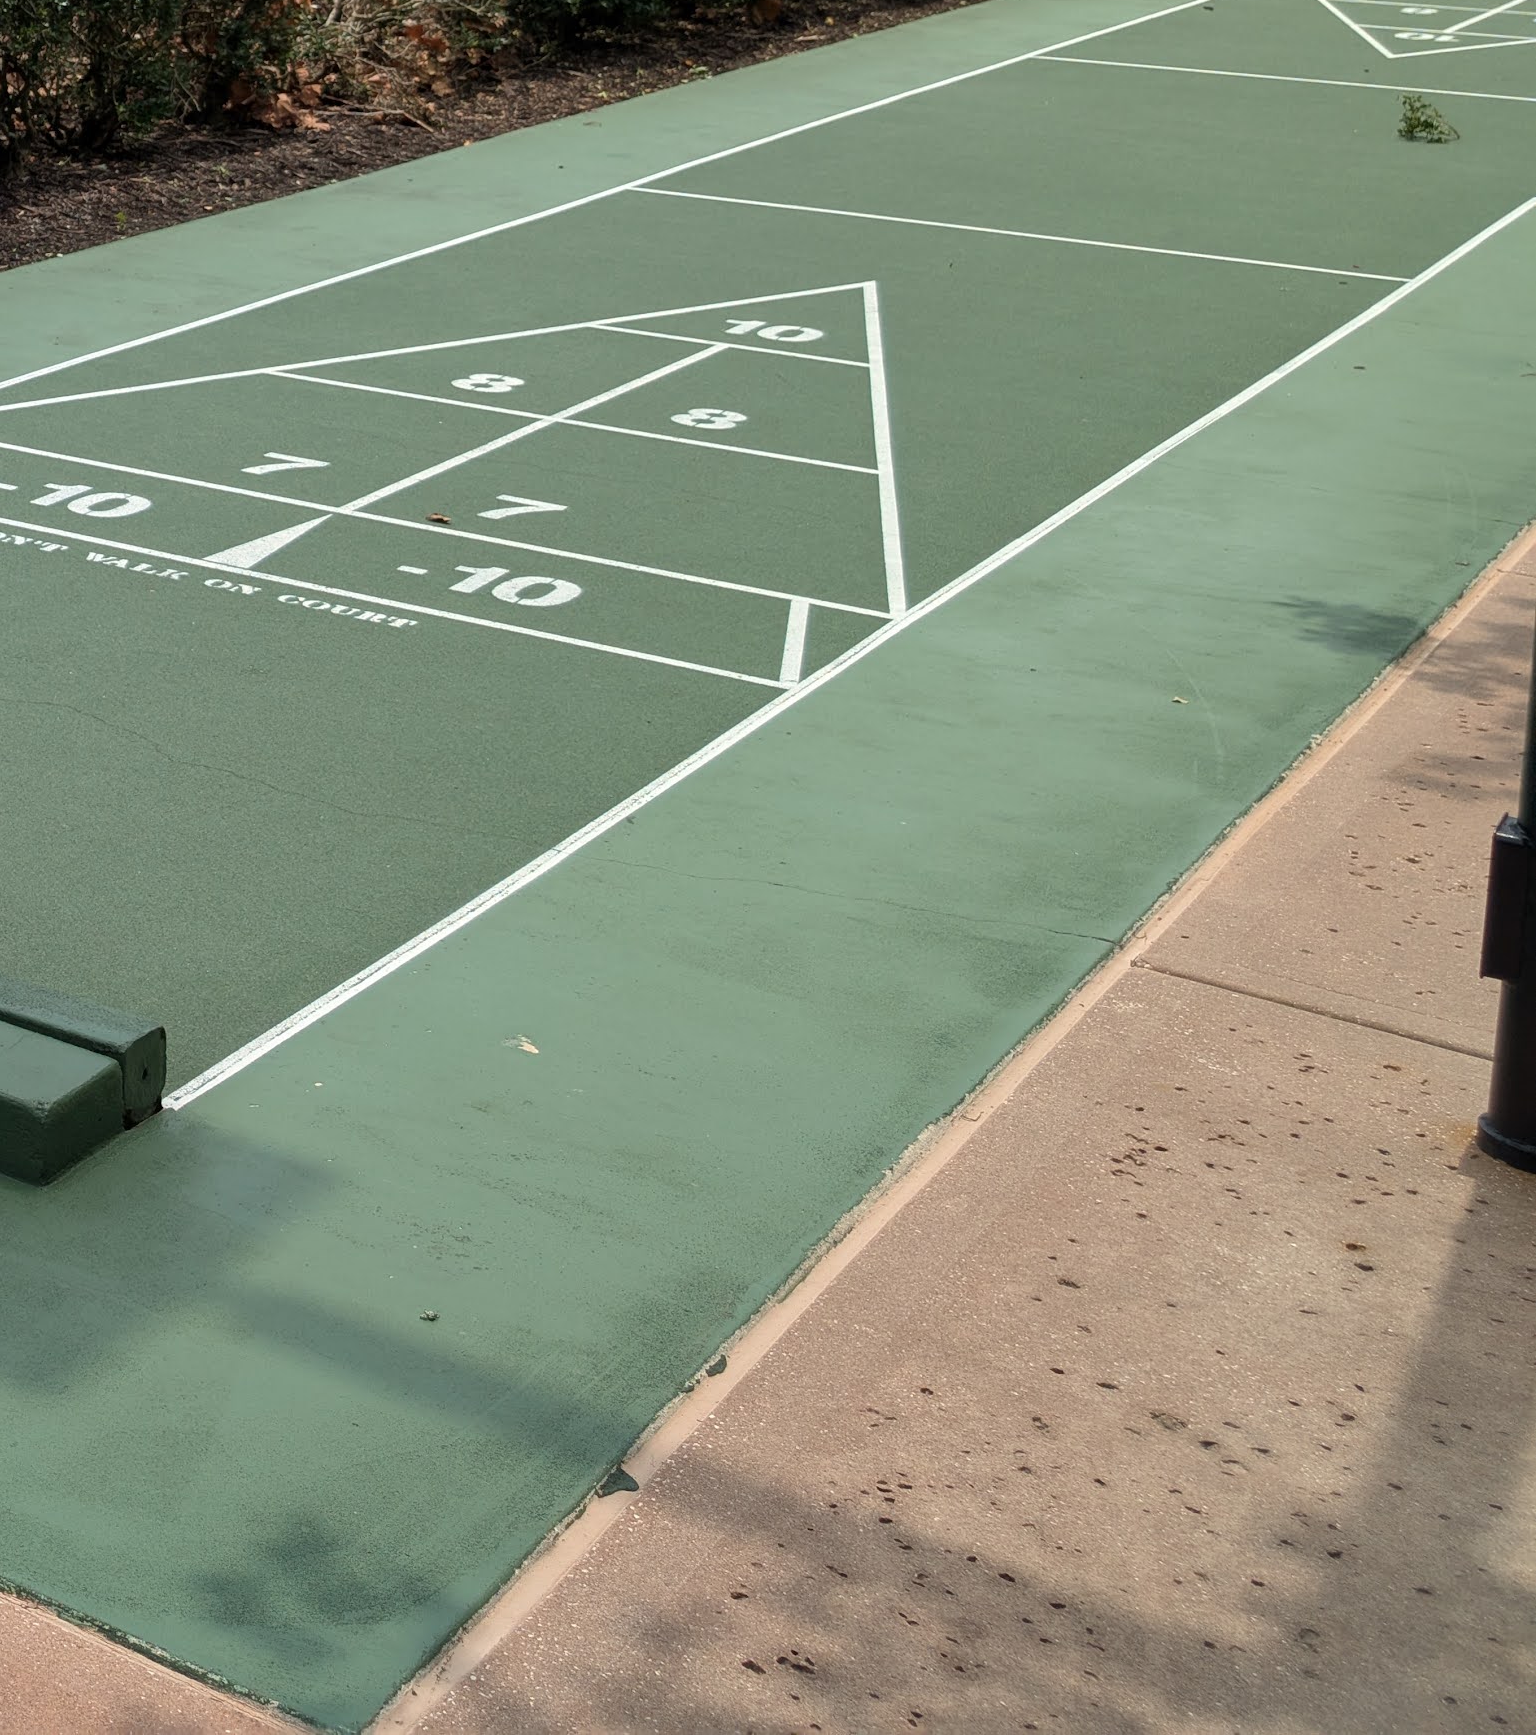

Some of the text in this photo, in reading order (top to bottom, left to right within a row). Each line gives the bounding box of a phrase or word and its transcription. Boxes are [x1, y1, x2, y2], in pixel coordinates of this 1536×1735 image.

[724, 318, 825, 342] 10
[450, 373, 526, 393] 8
[670, 408, 748, 430] 8
[240, 452, 331, 475] 7
[477, 494, 568, 520] 7
[86, 551, 189, 581] WALK
[204, 578, 262, 596] ON
[277, 593, 419, 629] COURT
[397, 565, 583, 607] -10
